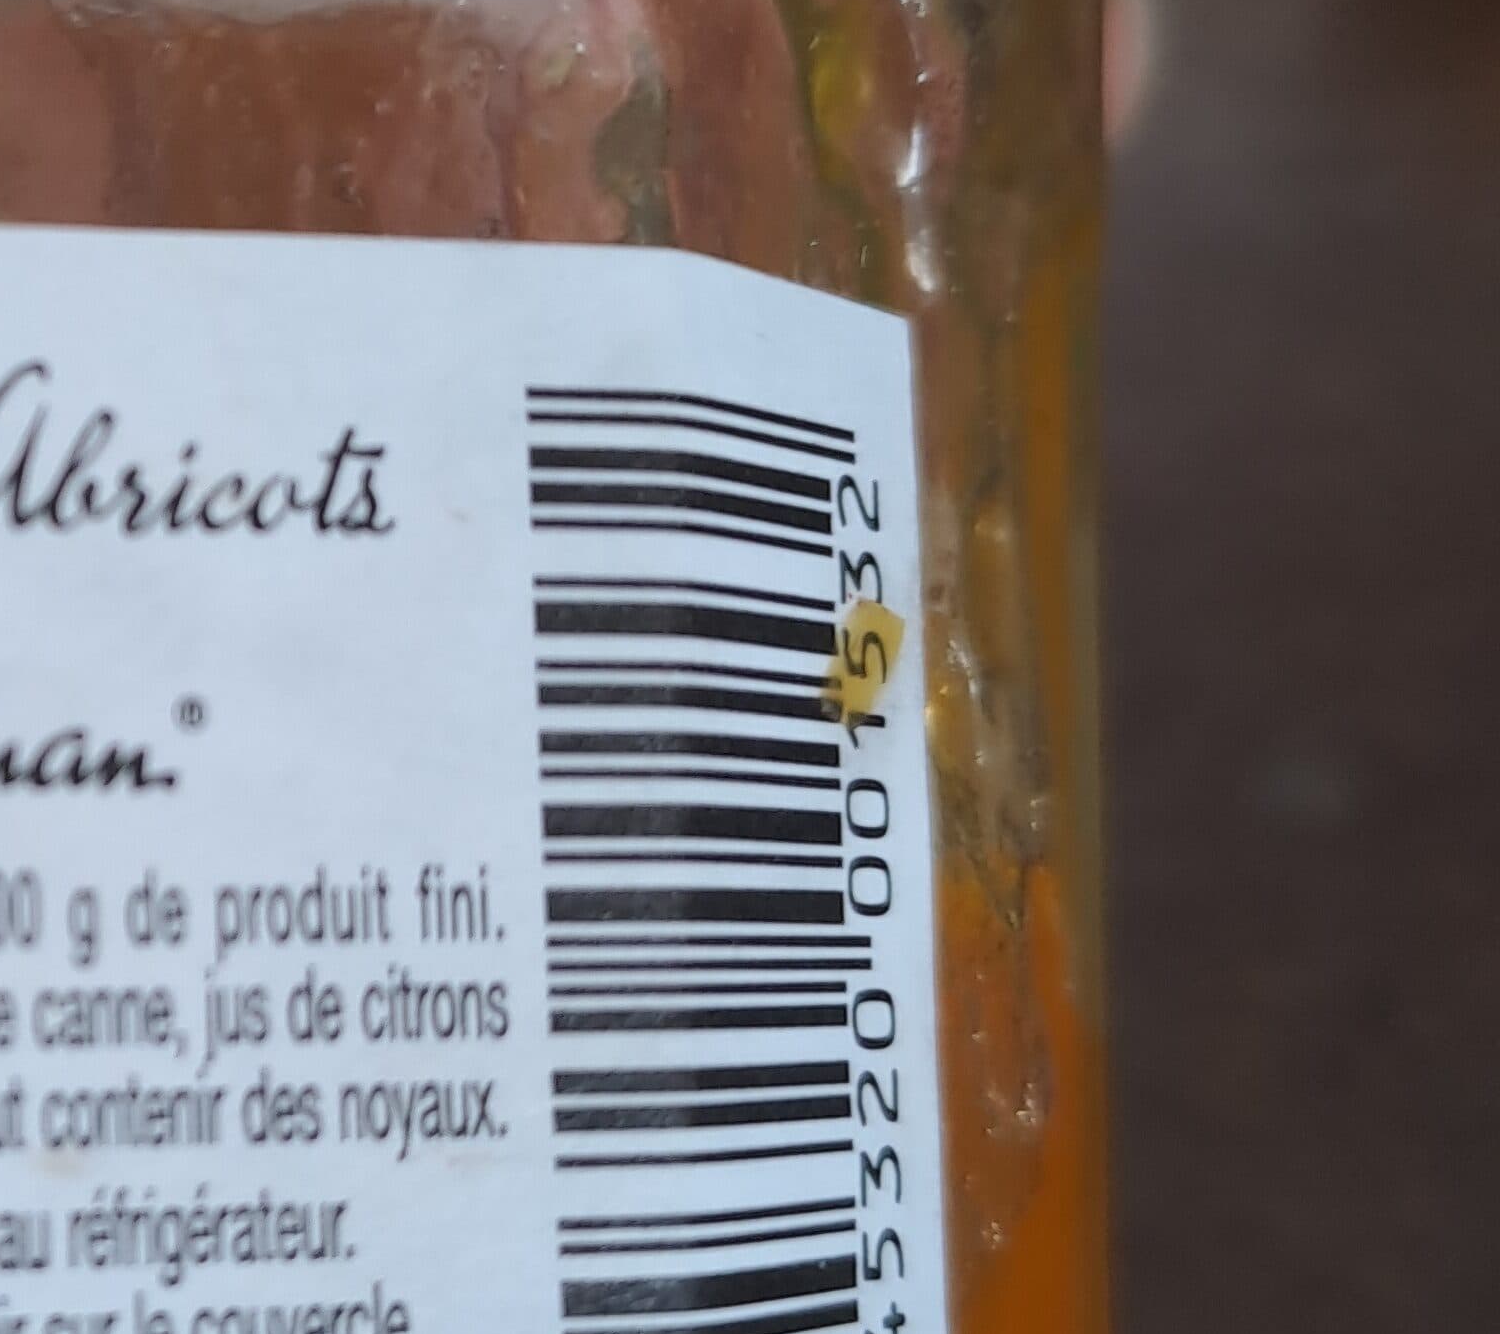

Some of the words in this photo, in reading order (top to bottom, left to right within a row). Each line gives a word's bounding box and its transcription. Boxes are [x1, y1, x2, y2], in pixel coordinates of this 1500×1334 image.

[67, 885, 99, 968] g
[124, 869, 188, 947] de
[214, 865, 390, 961] produit
[418, 865, 505, 942] fini.
[33, 985, 187, 1059] canne,
[198, 966, 269, 1077] jus
[287, 964, 342, 1043] de
[362, 964, 509, 1041] citrons
[41, 1072, 224, 1148] contenir
[241, 1067, 320, 1143] des
[340, 1080, 508, 1162] noyaux.
[67, 1182, 355, 1288] réfrigérateur.
